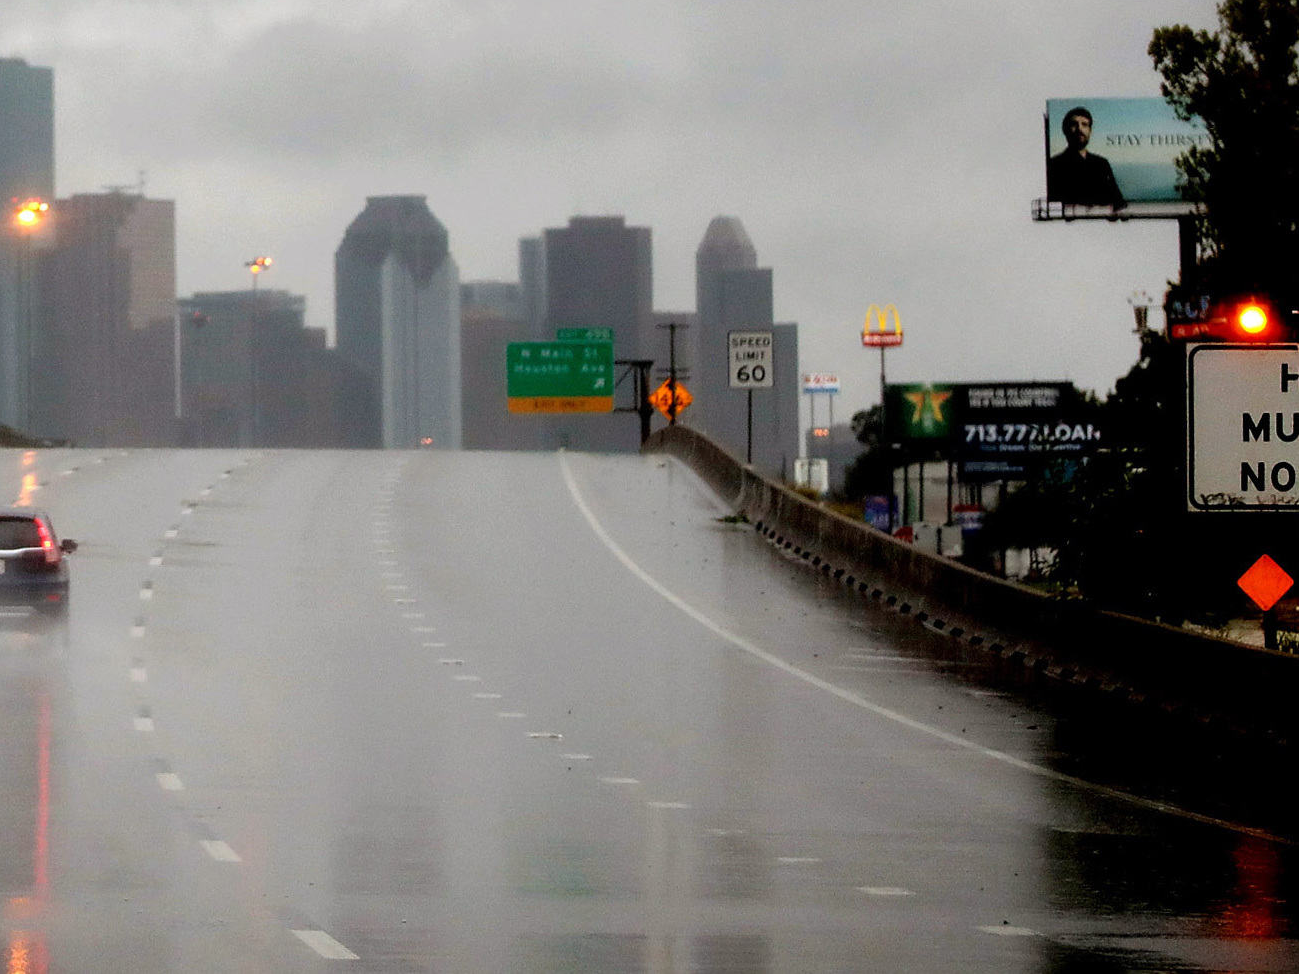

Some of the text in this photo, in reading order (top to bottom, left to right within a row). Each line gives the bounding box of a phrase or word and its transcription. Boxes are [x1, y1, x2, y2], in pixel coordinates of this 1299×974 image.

[1106, 133, 1142, 146] STAY
[731, 337, 770, 348] SPEED
[521, 348, 531, 358] N
[540, 348, 574, 358] Main
[735, 351, 765, 362] LIMIT
[580, 363, 606, 373] Ave
[737, 365, 766, 384] 60
[1242, 412, 1299, 443] MU
[1240, 461, 1296, 493] NO
